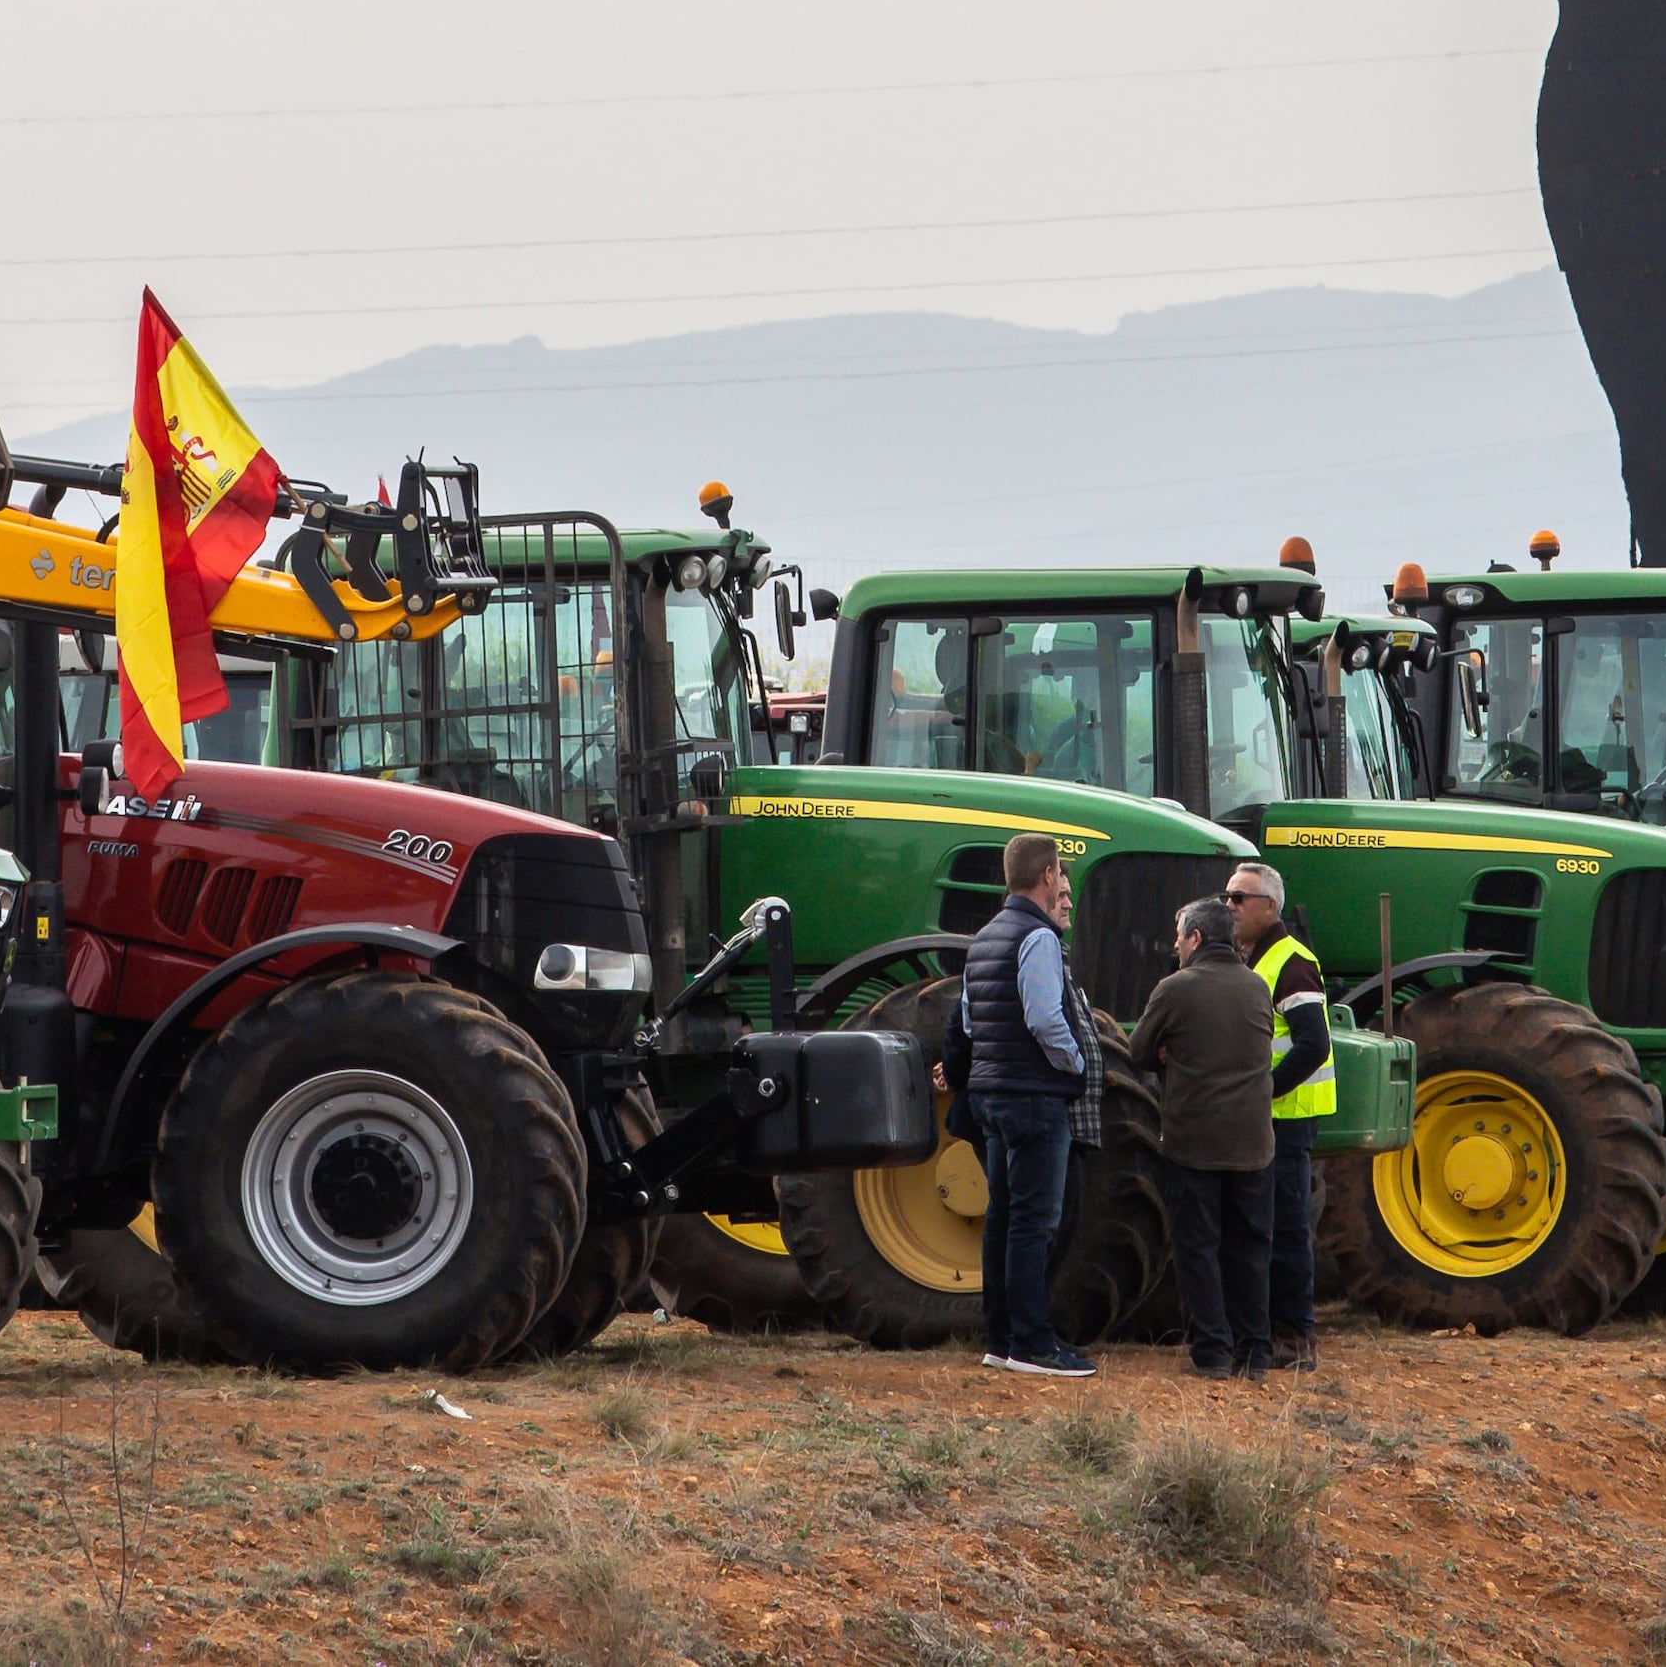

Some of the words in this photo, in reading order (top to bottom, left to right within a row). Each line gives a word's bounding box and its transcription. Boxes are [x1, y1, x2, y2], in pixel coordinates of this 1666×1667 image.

[106, 795, 171, 819] ASE
[753, 800, 799, 815] JOHN
[802, 801, 855, 816] DEERE
[1054, 838, 1087, 855] 530
[1290, 830, 1334, 846] JOHN
[1336, 831, 1386, 846] DEERE
[87, 840, 139, 857] PUMA
[381, 829, 453, 865] 200
[1556, 858, 1600, 875] 6930
